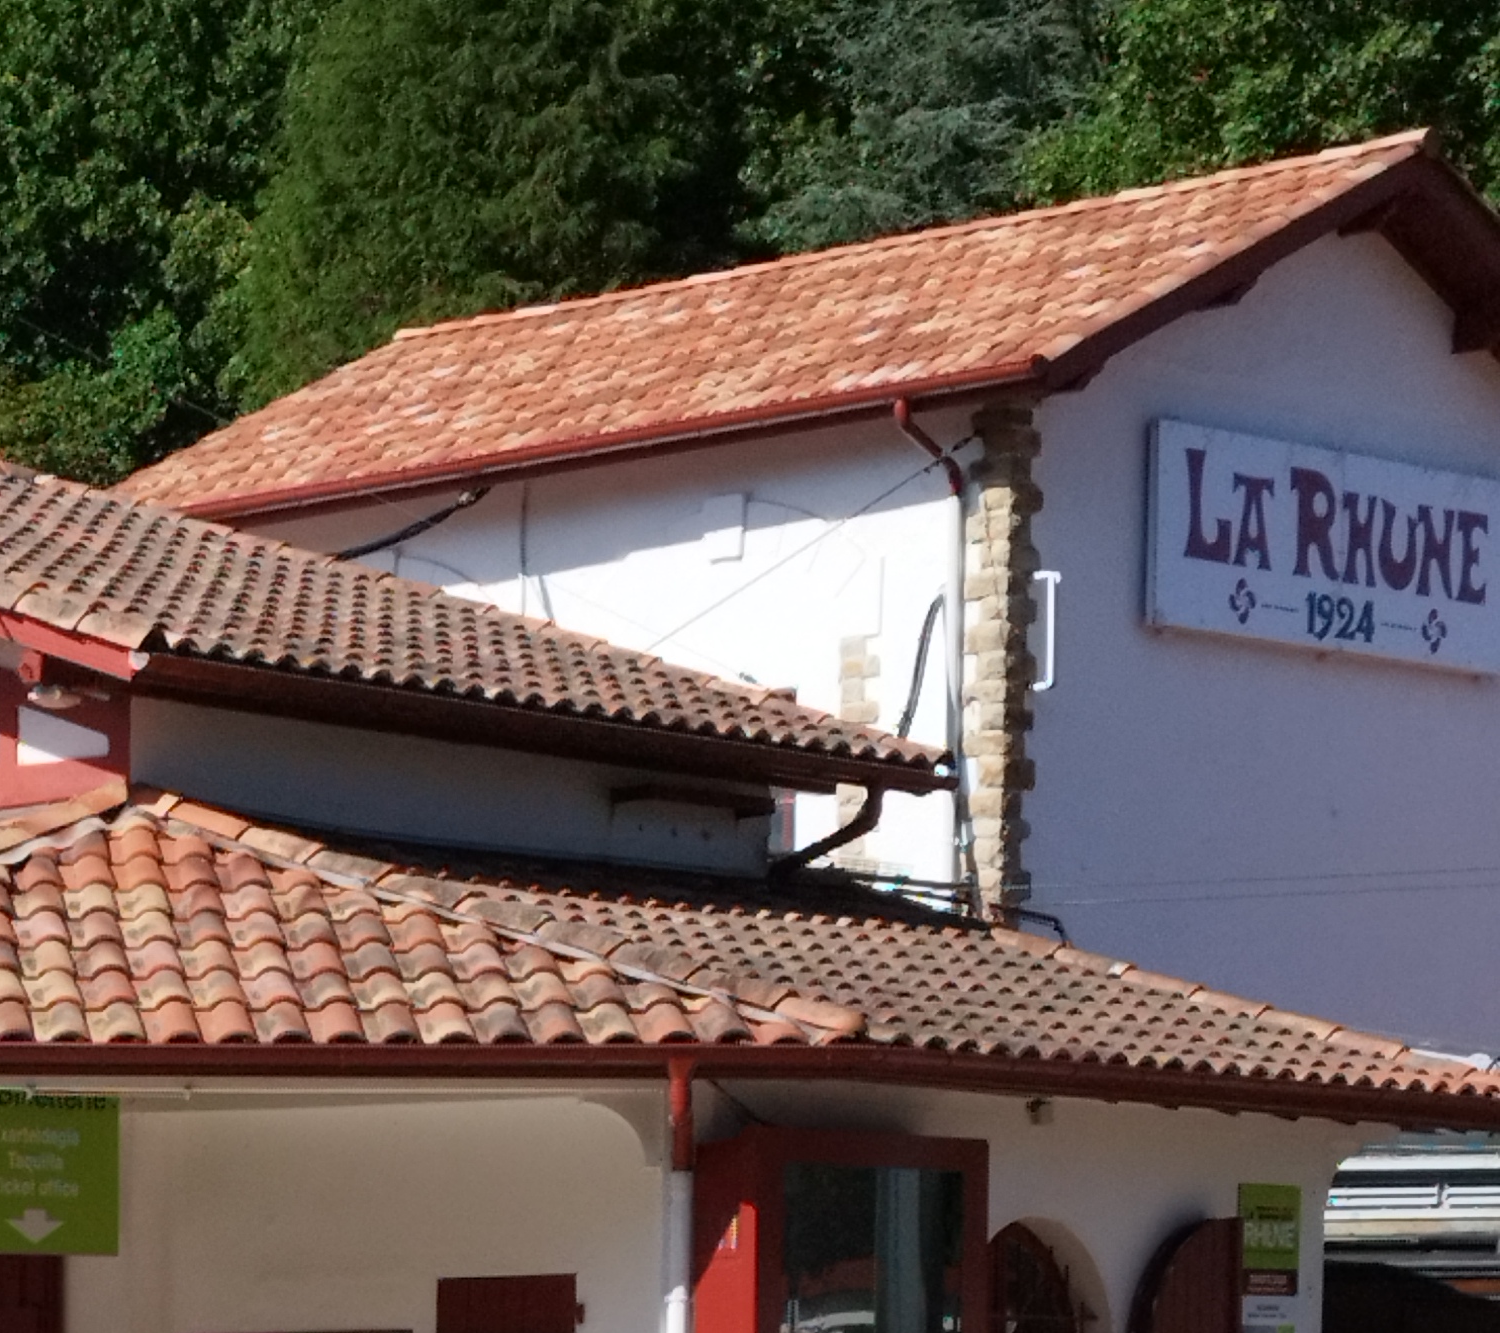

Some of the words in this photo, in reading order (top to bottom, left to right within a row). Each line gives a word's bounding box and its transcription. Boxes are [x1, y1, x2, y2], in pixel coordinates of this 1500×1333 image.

[1184, 448, 1274, 571] LA
[1290, 466, 1488, 606] RHUNE
[1305, 591, 1374, 642] 1924
